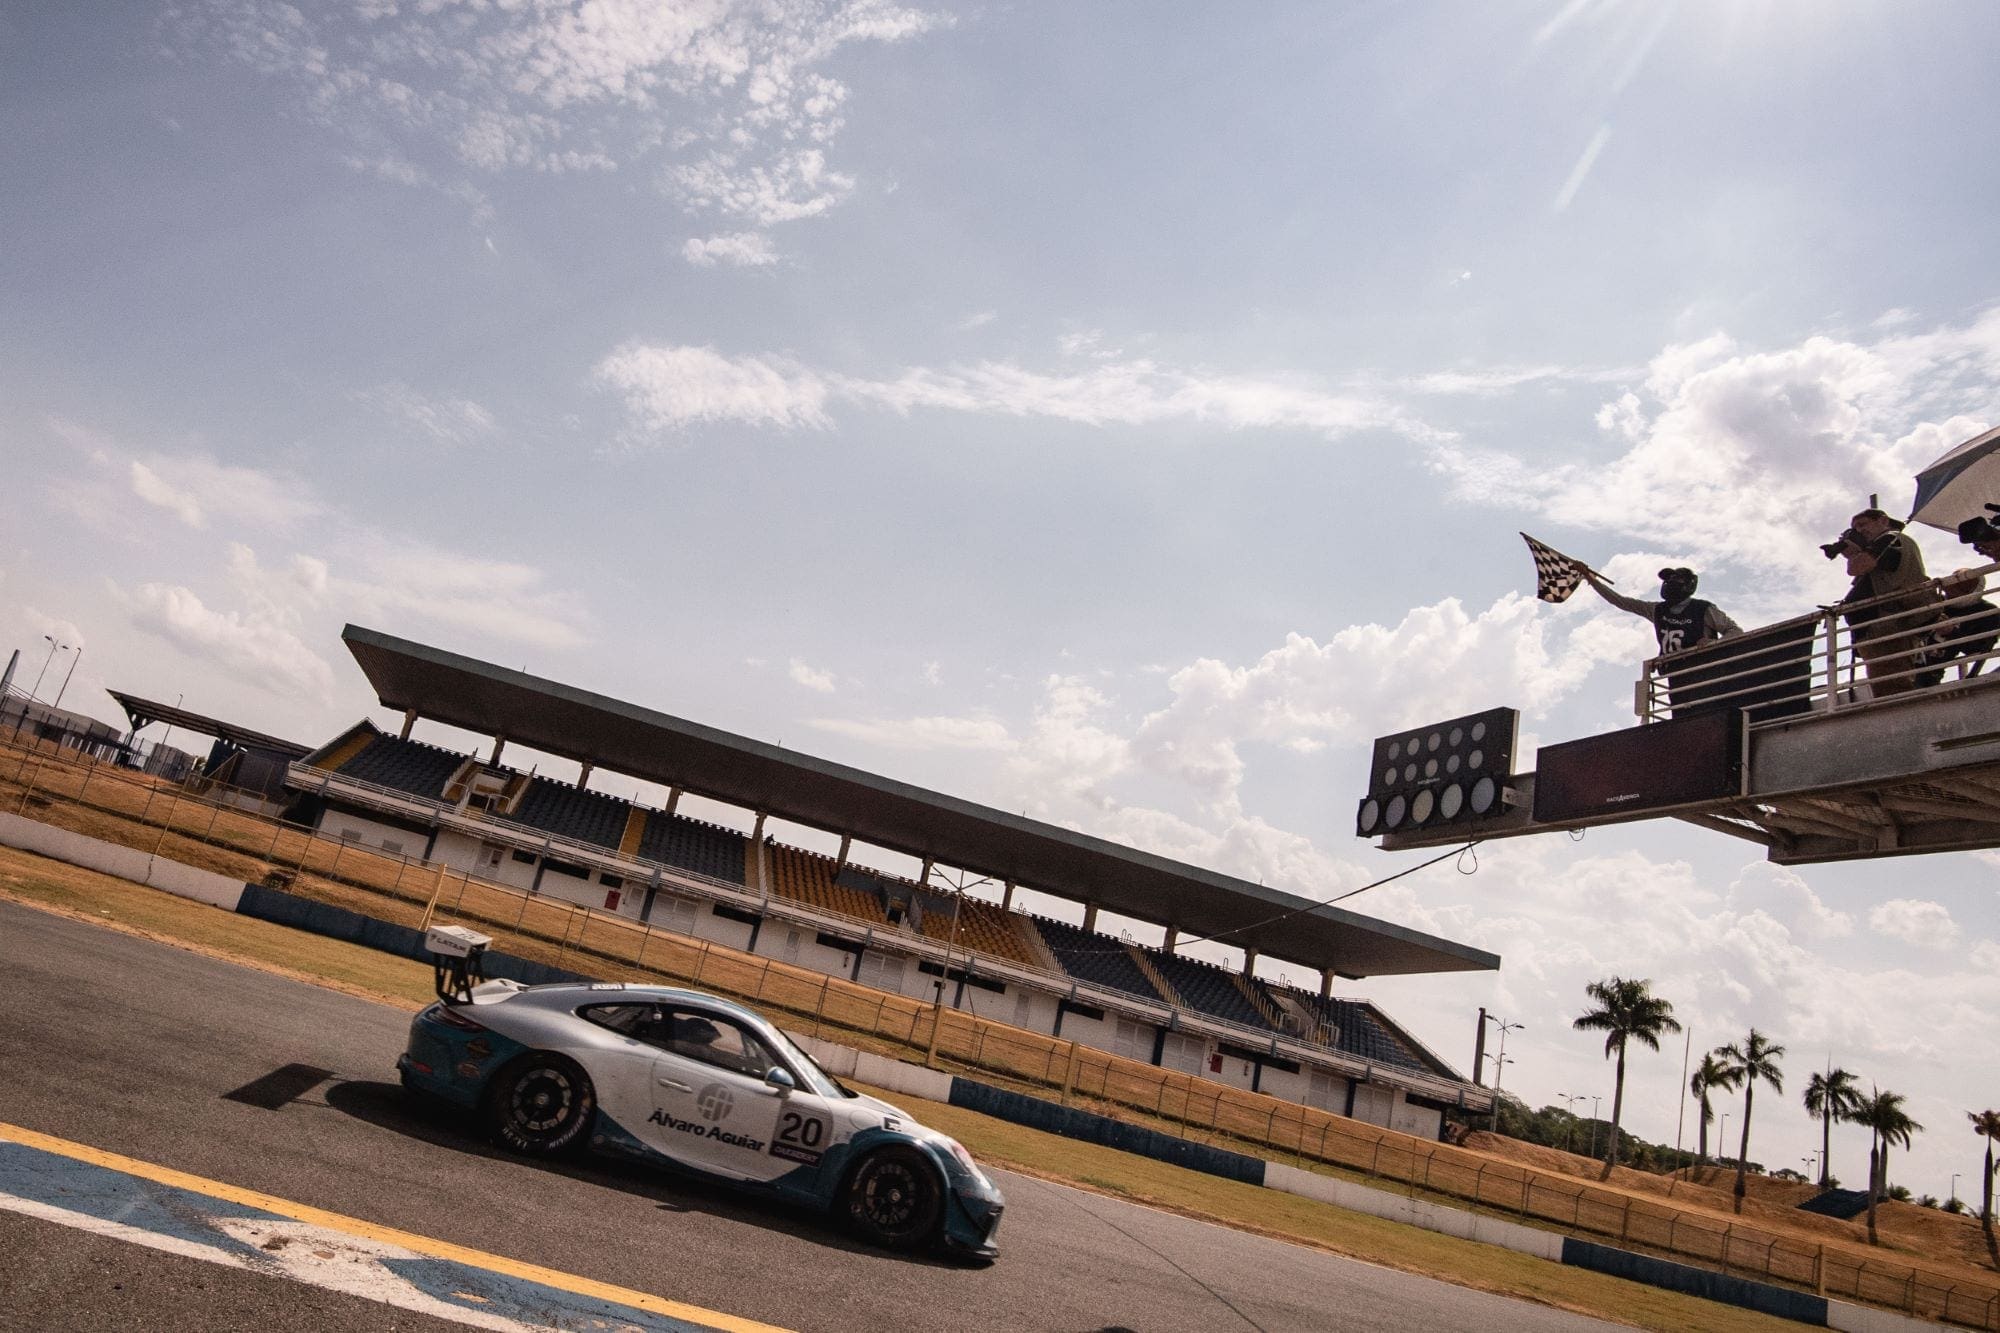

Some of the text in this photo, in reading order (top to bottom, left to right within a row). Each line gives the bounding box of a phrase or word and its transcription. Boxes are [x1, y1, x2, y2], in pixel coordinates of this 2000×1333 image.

[647, 1108, 766, 1151] Álvaro Aguiar
[780, 1112, 823, 1147] 20
